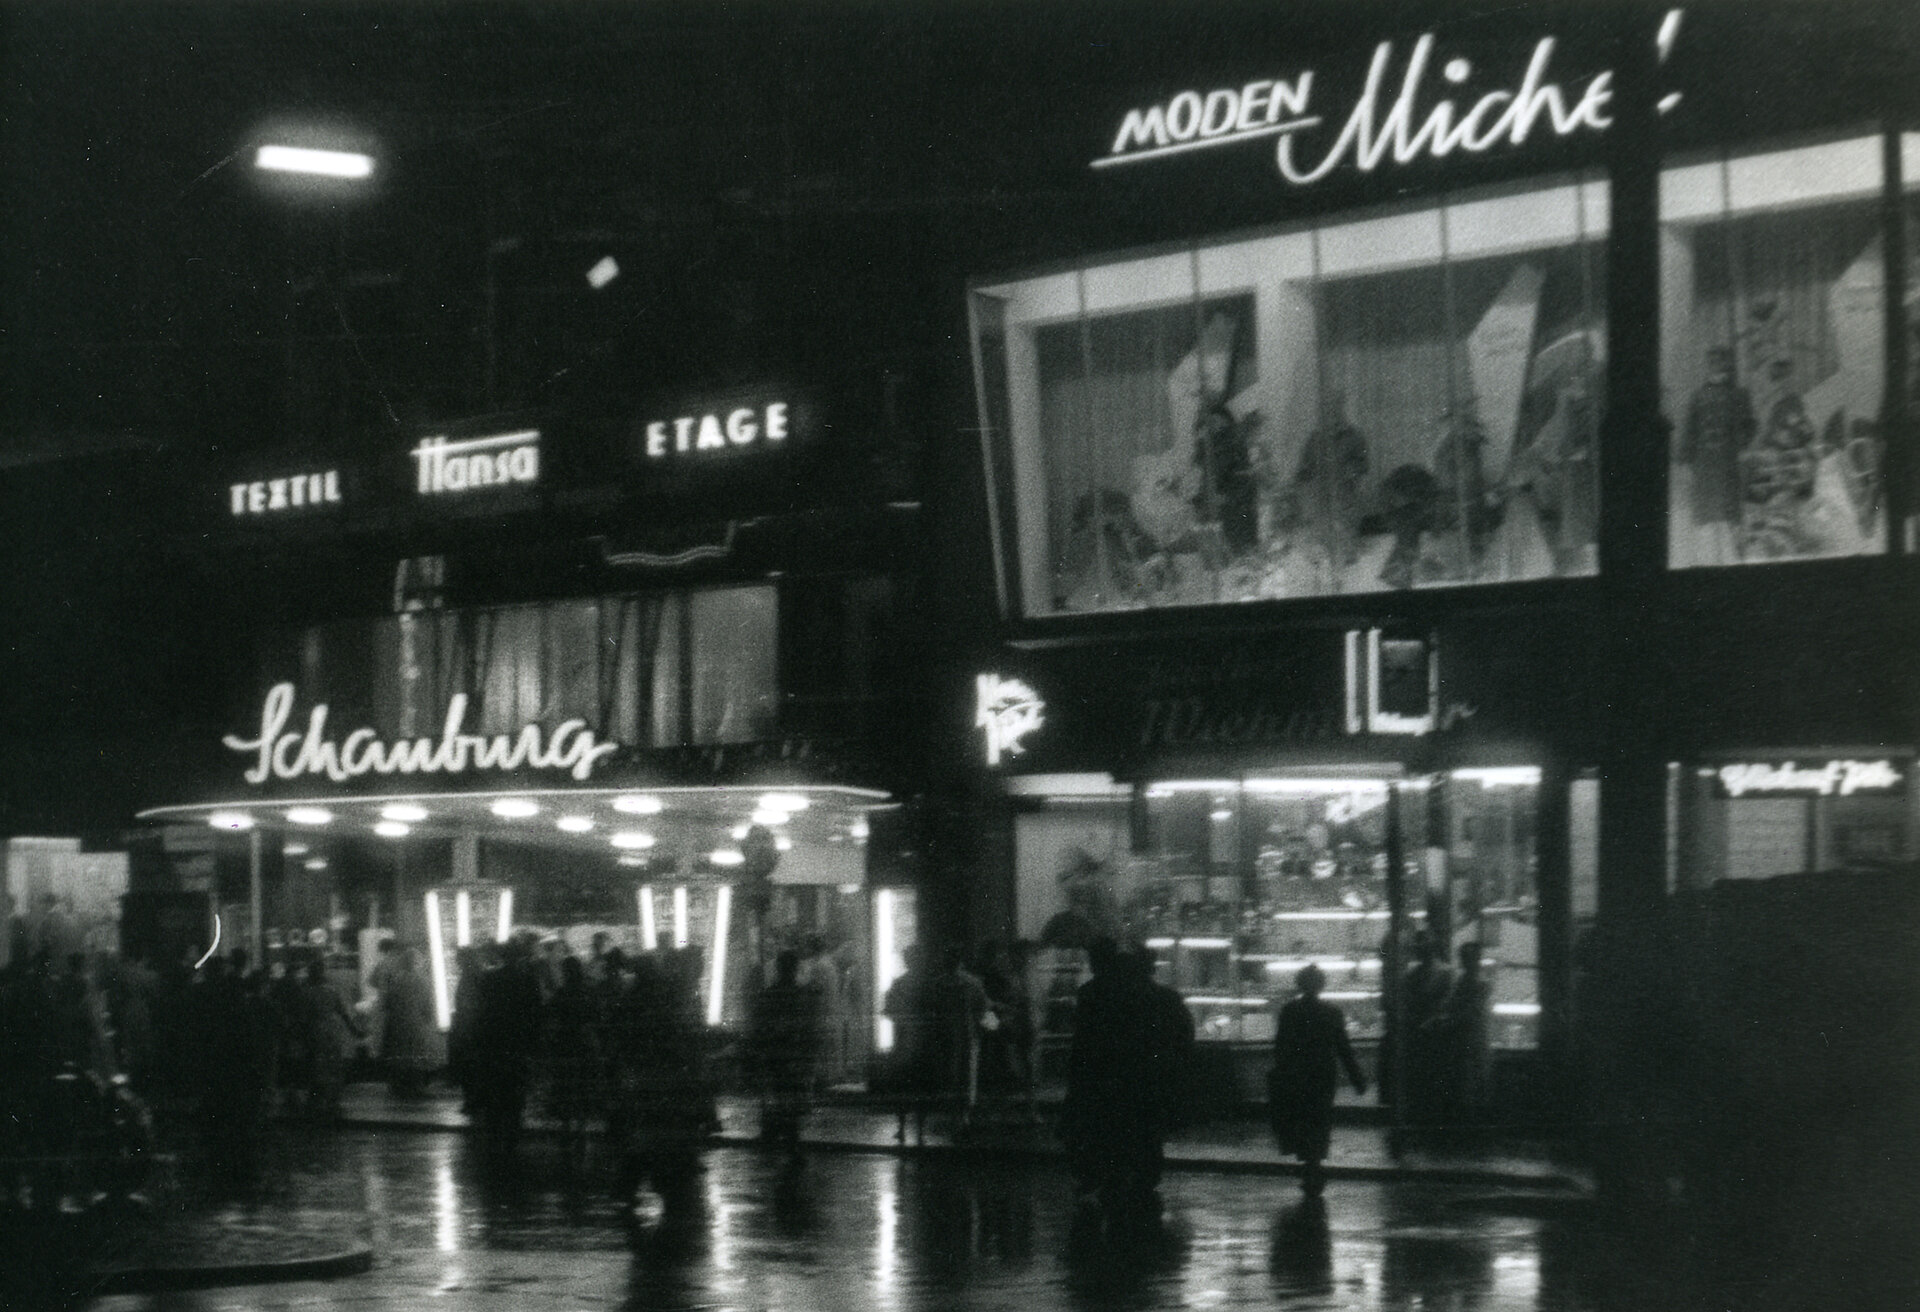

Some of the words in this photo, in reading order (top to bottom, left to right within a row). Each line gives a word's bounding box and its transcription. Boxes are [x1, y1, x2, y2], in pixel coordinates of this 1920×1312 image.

[1112, 70, 1315, 155] MODEN
[229, 470, 342, 516] TEXTIL
[410, 429, 540, 495] Hansa
[644, 401, 789, 459] ETAGE
[221, 681, 619, 784] Schauburg
